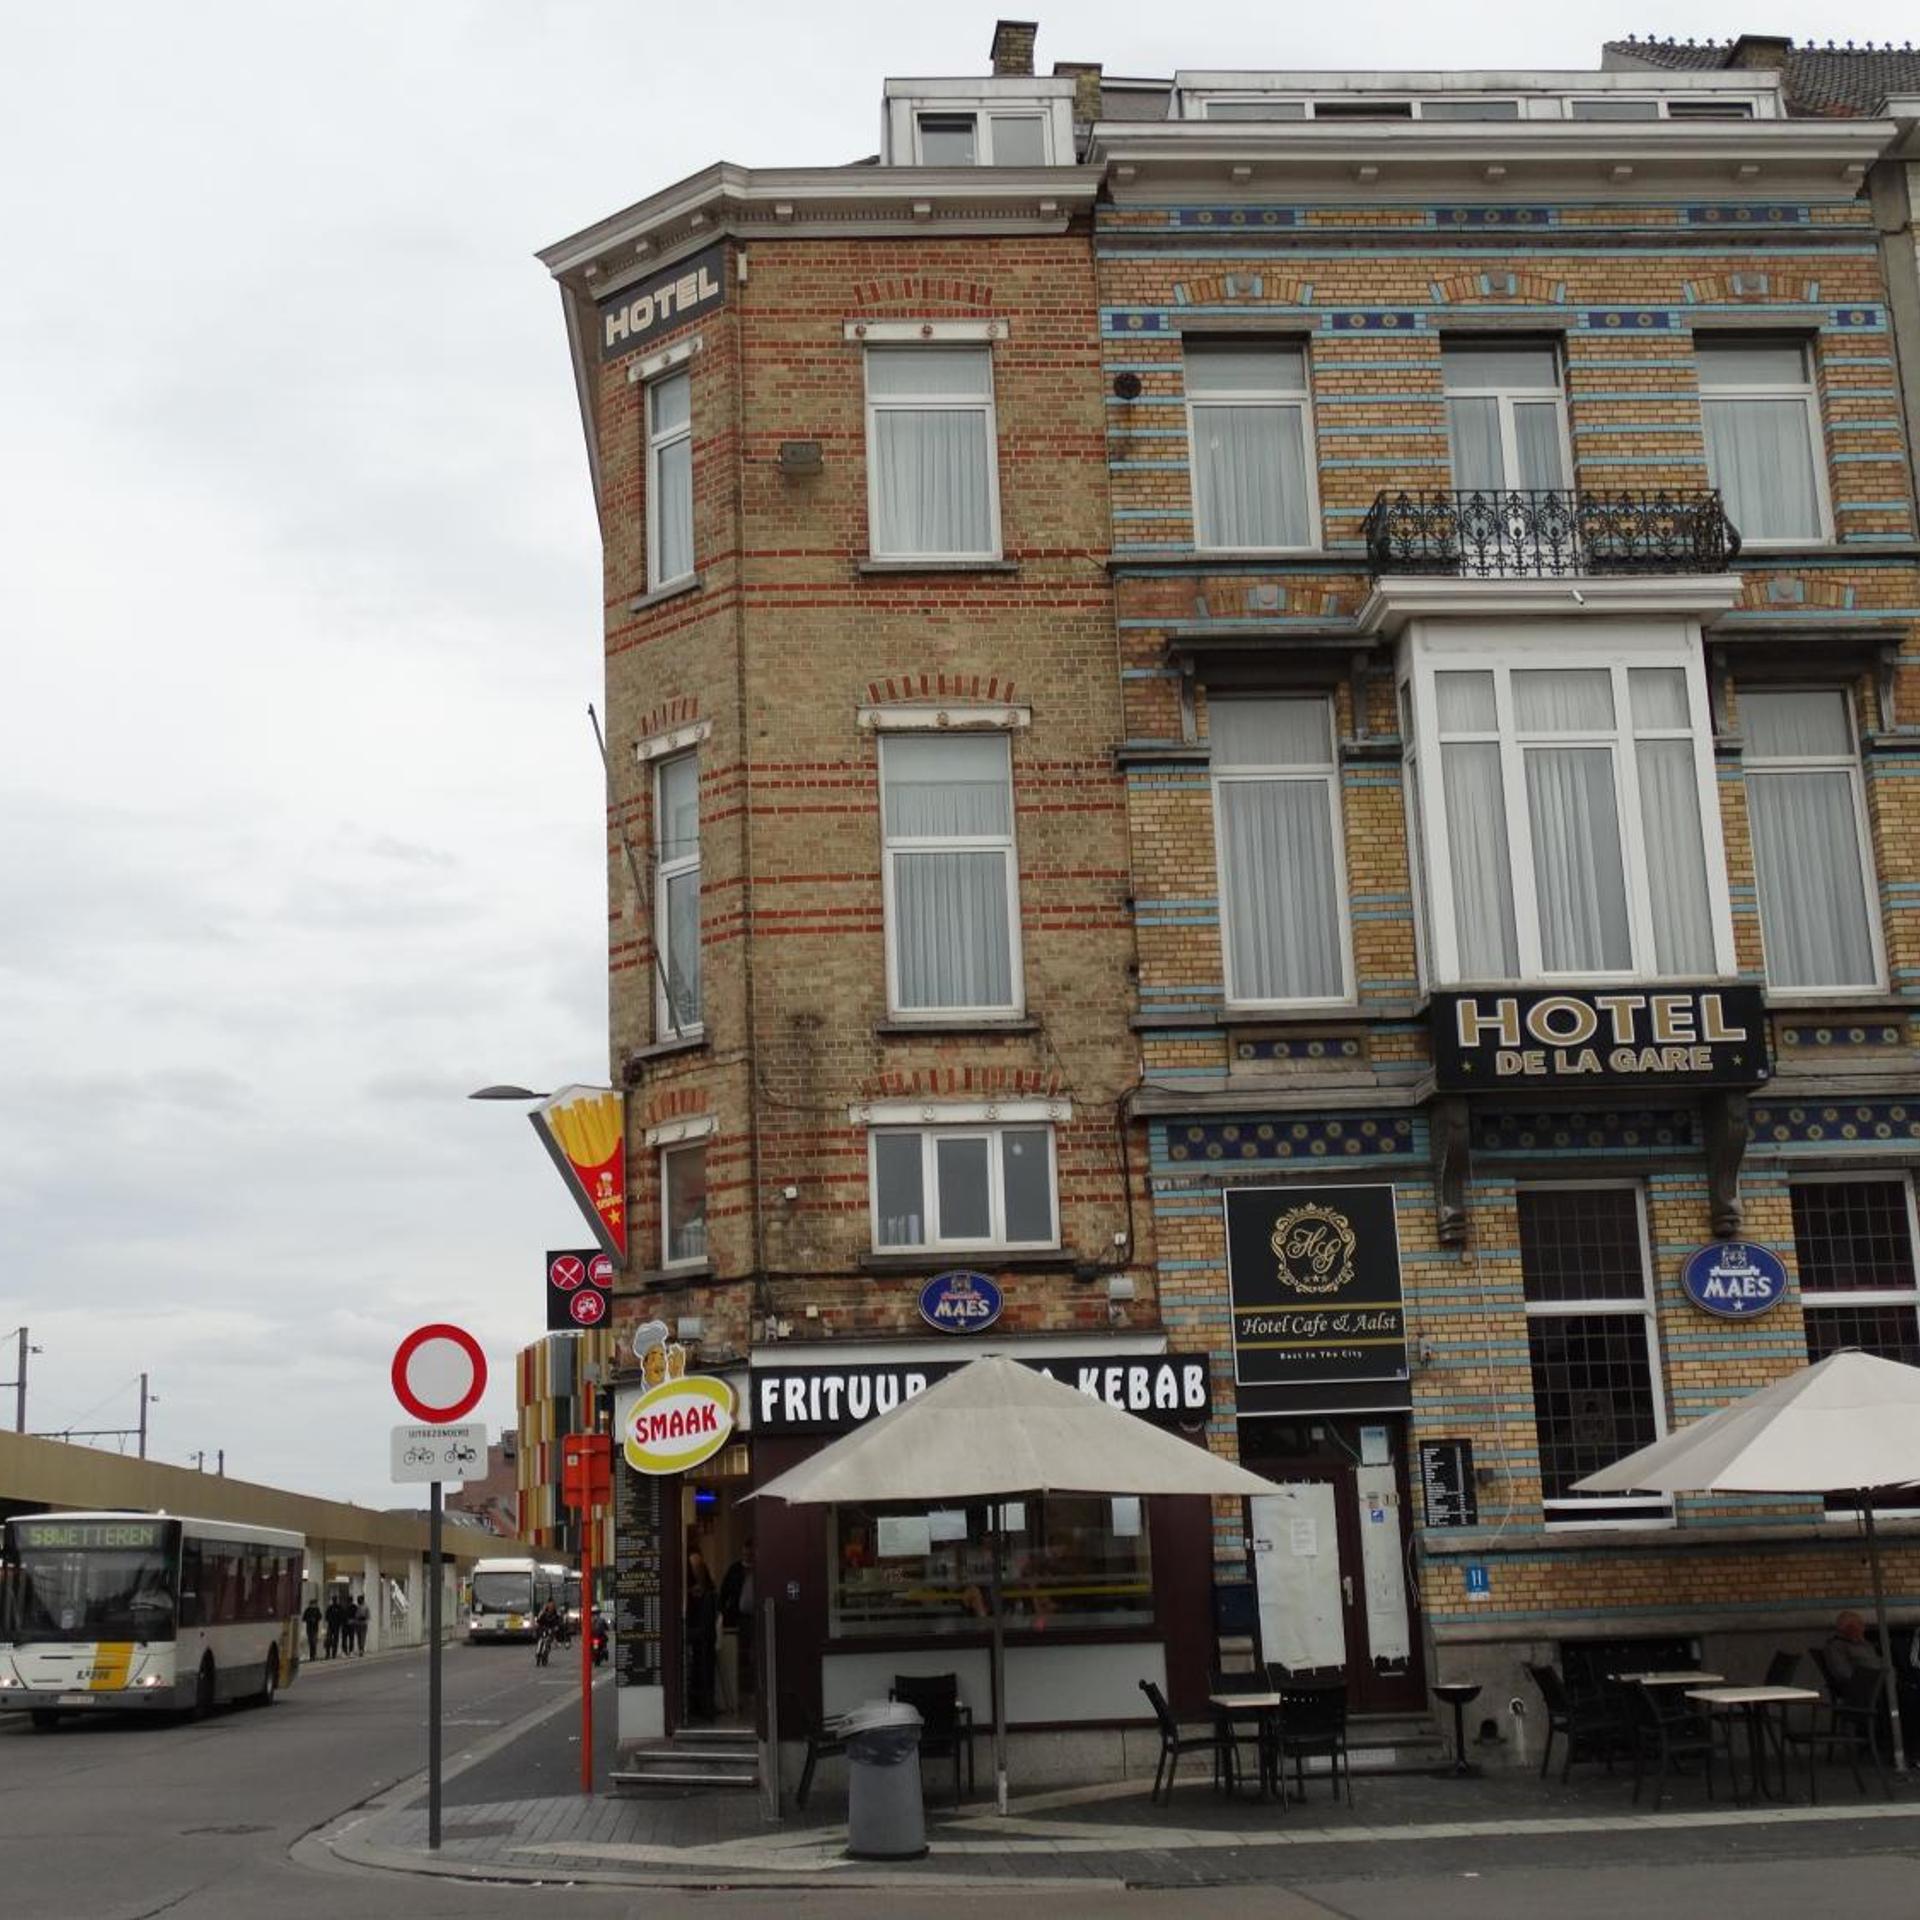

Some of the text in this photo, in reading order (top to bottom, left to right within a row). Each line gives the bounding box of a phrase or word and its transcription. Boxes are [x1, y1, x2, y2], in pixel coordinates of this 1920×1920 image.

[605, 266, 719, 348] HOTEL
[1456, 994, 1747, 1047] HOTEL
[1495, 1045, 1713, 1075] DE LA GARE
[1703, 1277, 1772, 1298] MAES
[934, 1299, 990, 1317] MAES
[1242, 1311, 1397, 1337] Hotel Cafe & Aalst
[1078, 1364, 1206, 1410] KEBAB
[635, 1403, 718, 1444] SMAAK
[54, 1526, 154, 1545] WETTEREN
